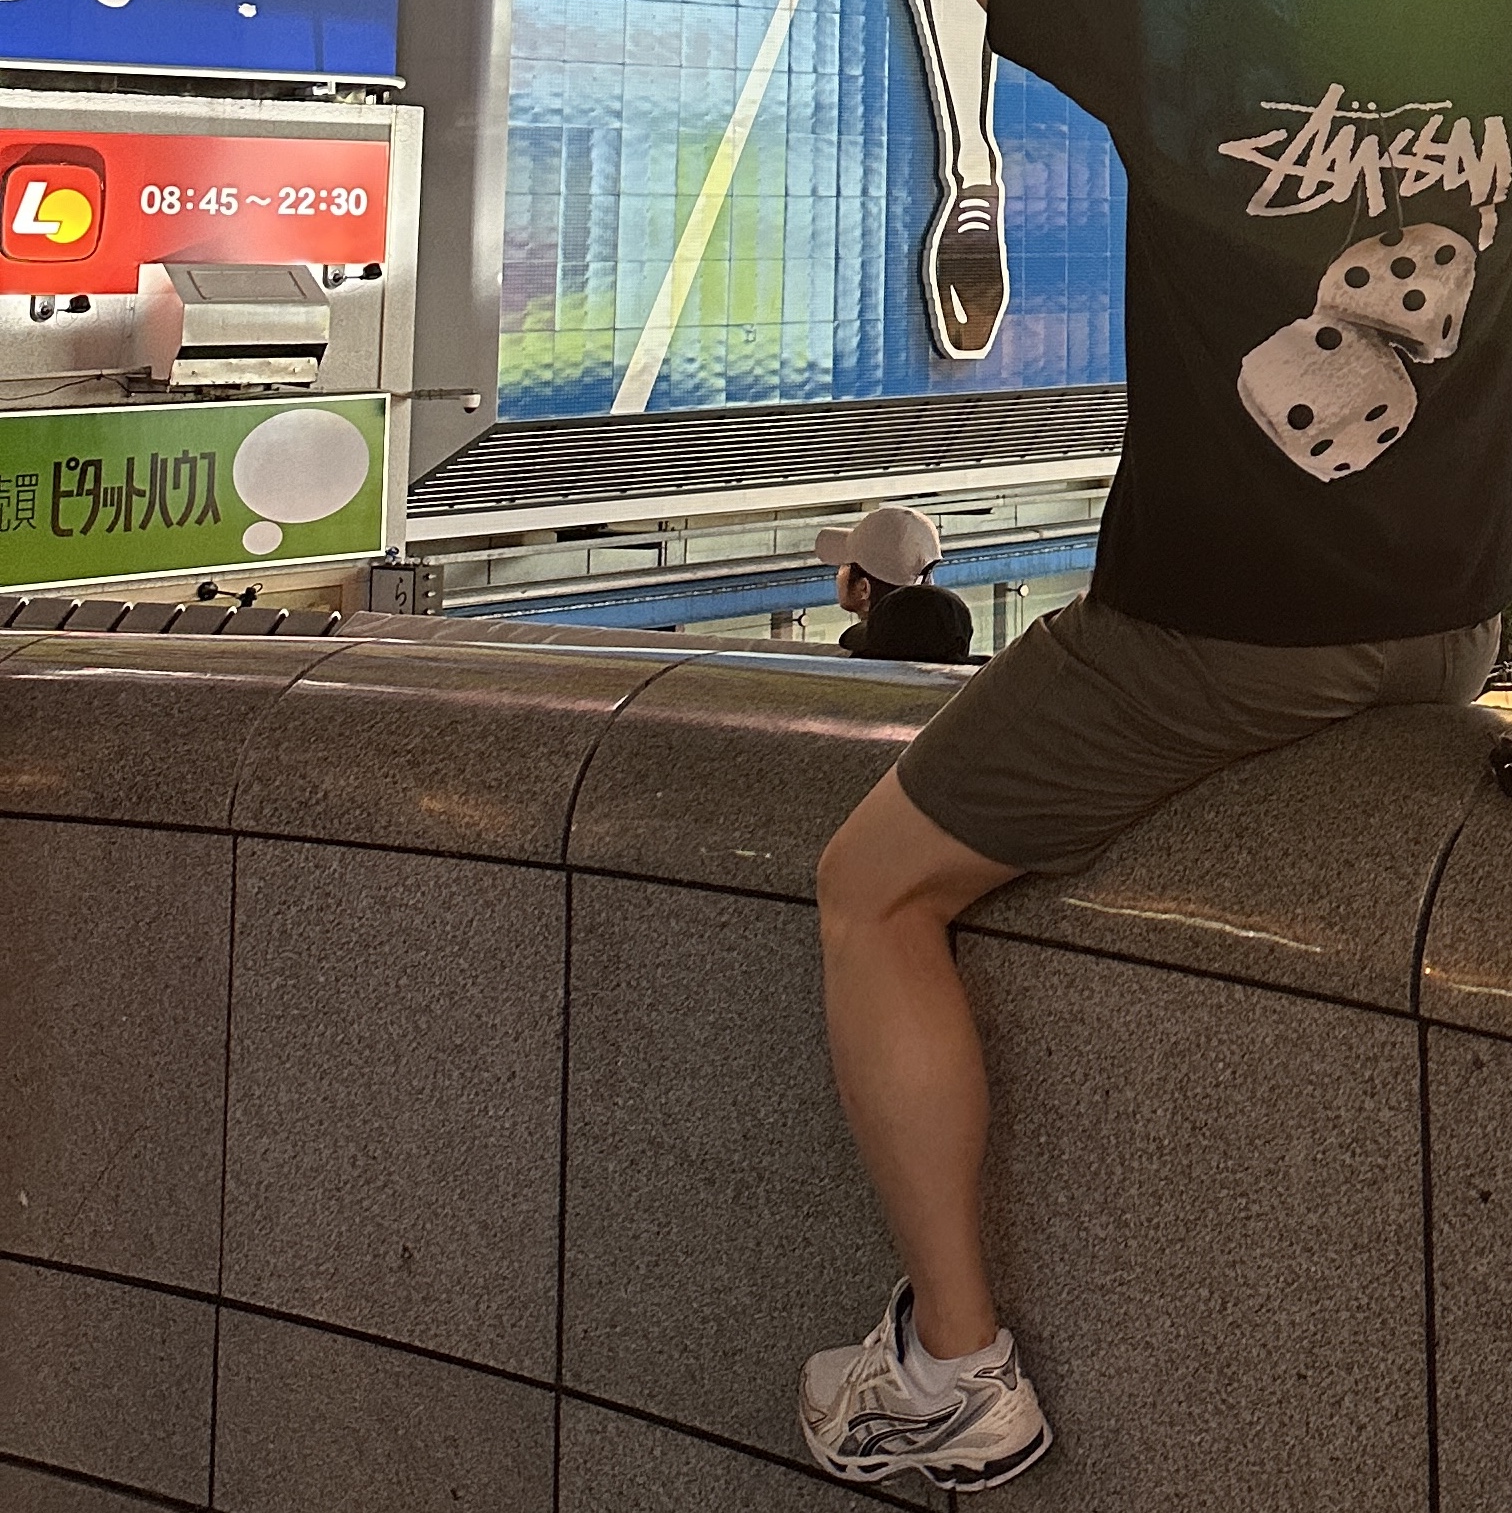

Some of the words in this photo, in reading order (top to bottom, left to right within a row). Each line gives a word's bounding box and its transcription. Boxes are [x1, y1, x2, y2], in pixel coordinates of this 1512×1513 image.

[50, 449, 221, 538] ピタットハウス
